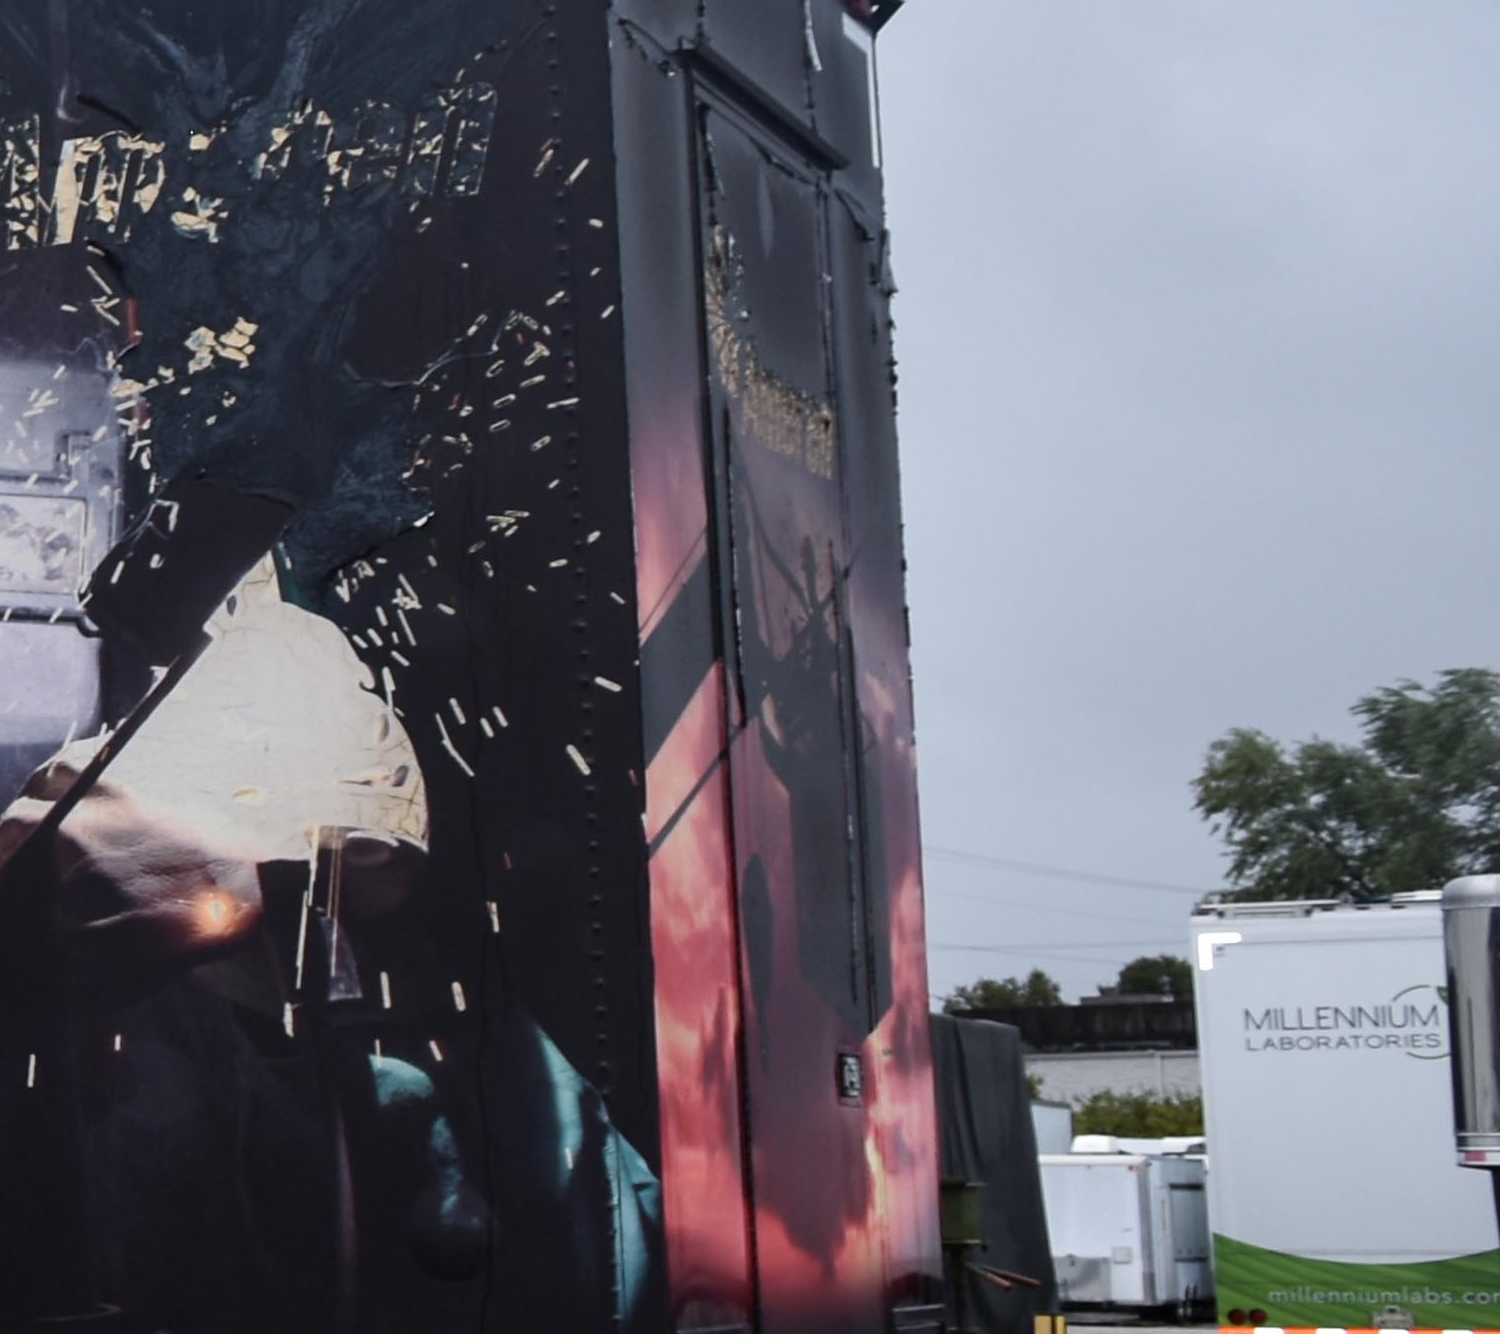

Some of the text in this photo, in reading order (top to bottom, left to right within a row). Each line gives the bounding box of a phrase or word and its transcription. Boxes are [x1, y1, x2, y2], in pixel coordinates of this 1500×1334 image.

[1244, 1004, 1440, 1031] MILLENNIUM
[1246, 1033, 1442, 1052] LABORATORIES
[1267, 1285, 1500, 1305] millenniumlabs.co
